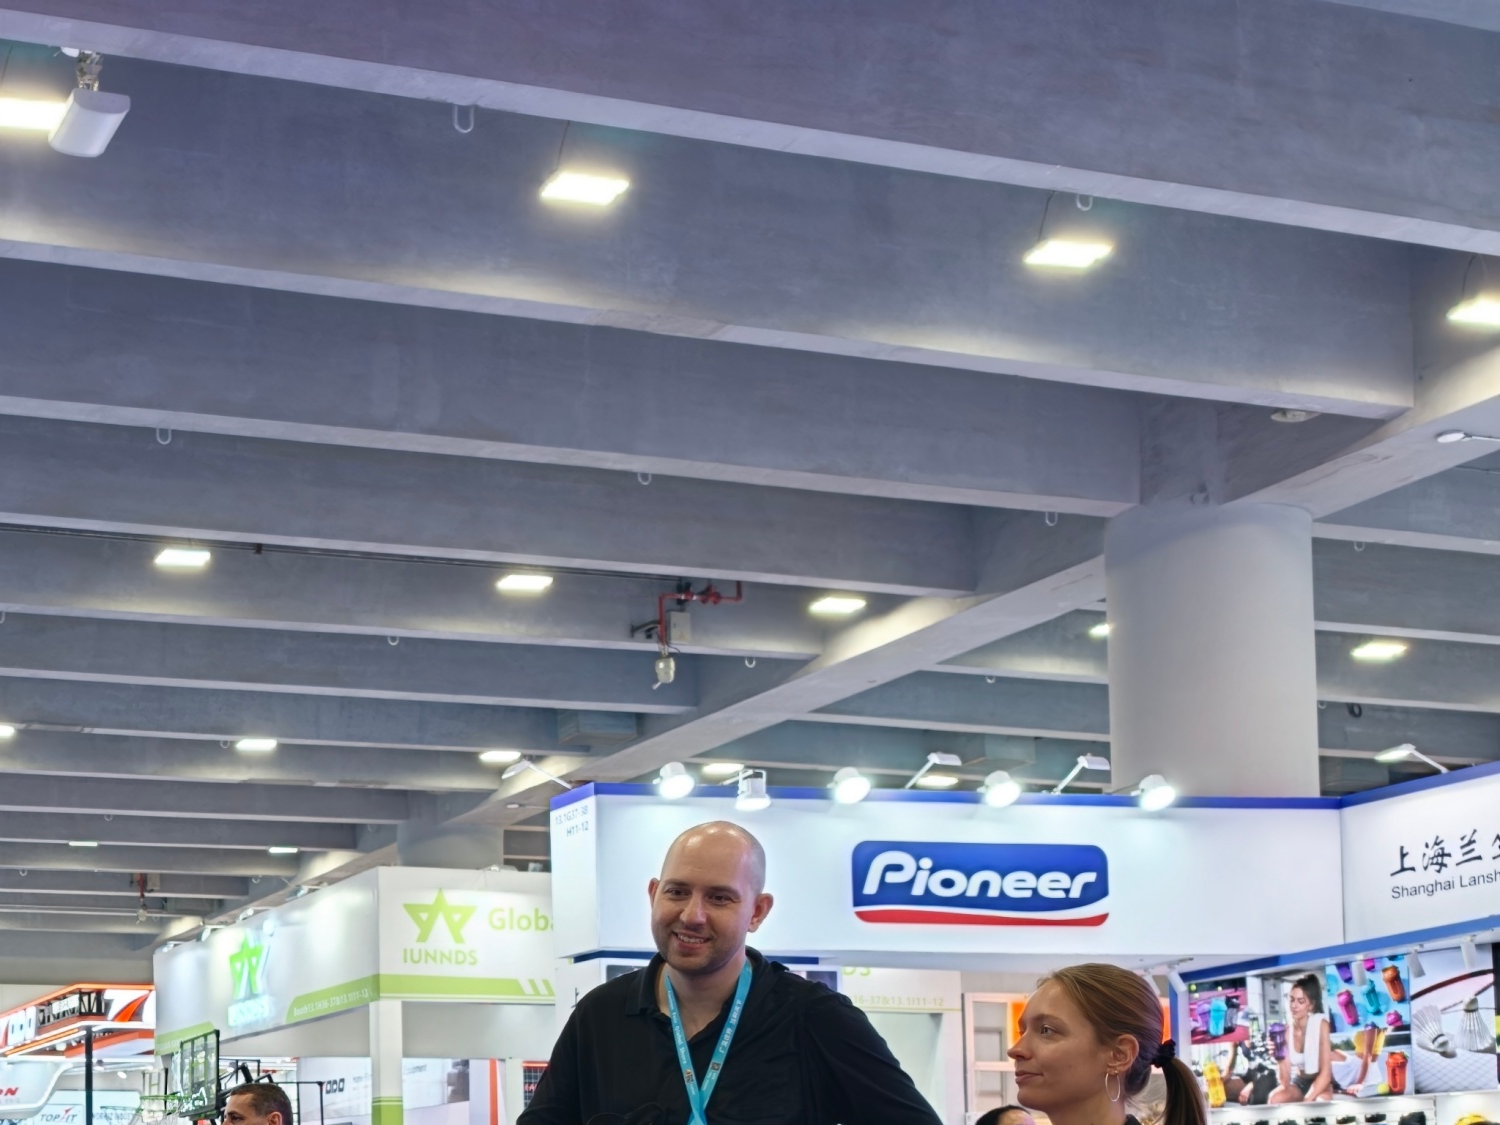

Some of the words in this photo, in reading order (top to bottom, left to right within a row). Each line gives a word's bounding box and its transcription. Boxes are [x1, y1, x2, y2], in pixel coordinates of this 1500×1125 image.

[861, 850, 1098, 899] Pioneer
[1391, 876, 1455, 899] Shanghai
[487, 906, 553, 932] Glob
